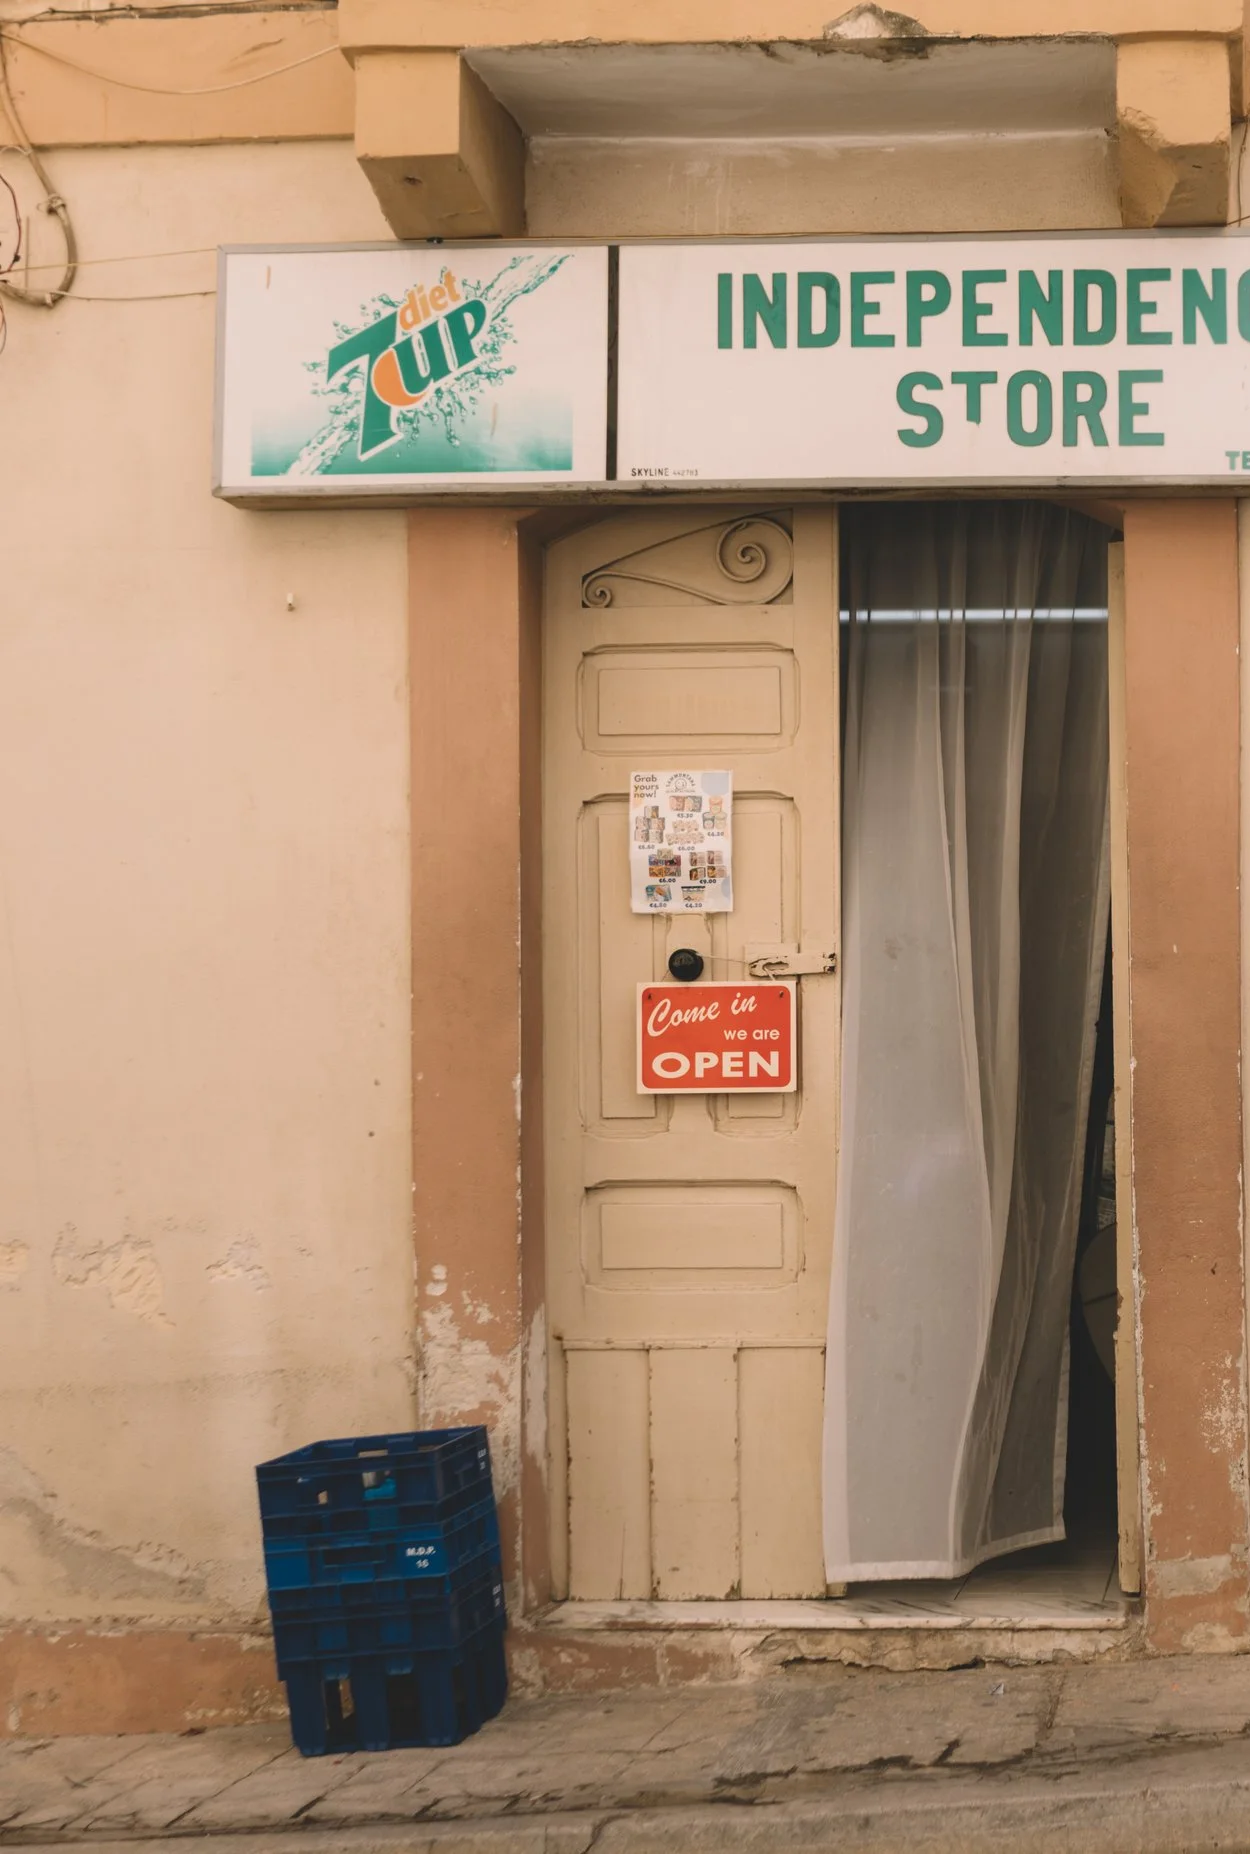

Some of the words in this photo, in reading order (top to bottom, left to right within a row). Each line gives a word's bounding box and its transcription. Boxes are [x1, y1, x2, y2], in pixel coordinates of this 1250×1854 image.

[399, 269, 461, 331] diet
[896, 369, 1166, 448] STORE
[631, 467, 670, 478] SKYLINE
[633, 774, 658, 783] Grab
[633, 790, 658, 799] now!
[647, 998, 721, 1038] Come
[730, 992, 758, 1016] in
[723, 1029, 748, 1041] we
[752, 1028, 781, 1041] are
[651, 1051, 780, 1079] OPEN
